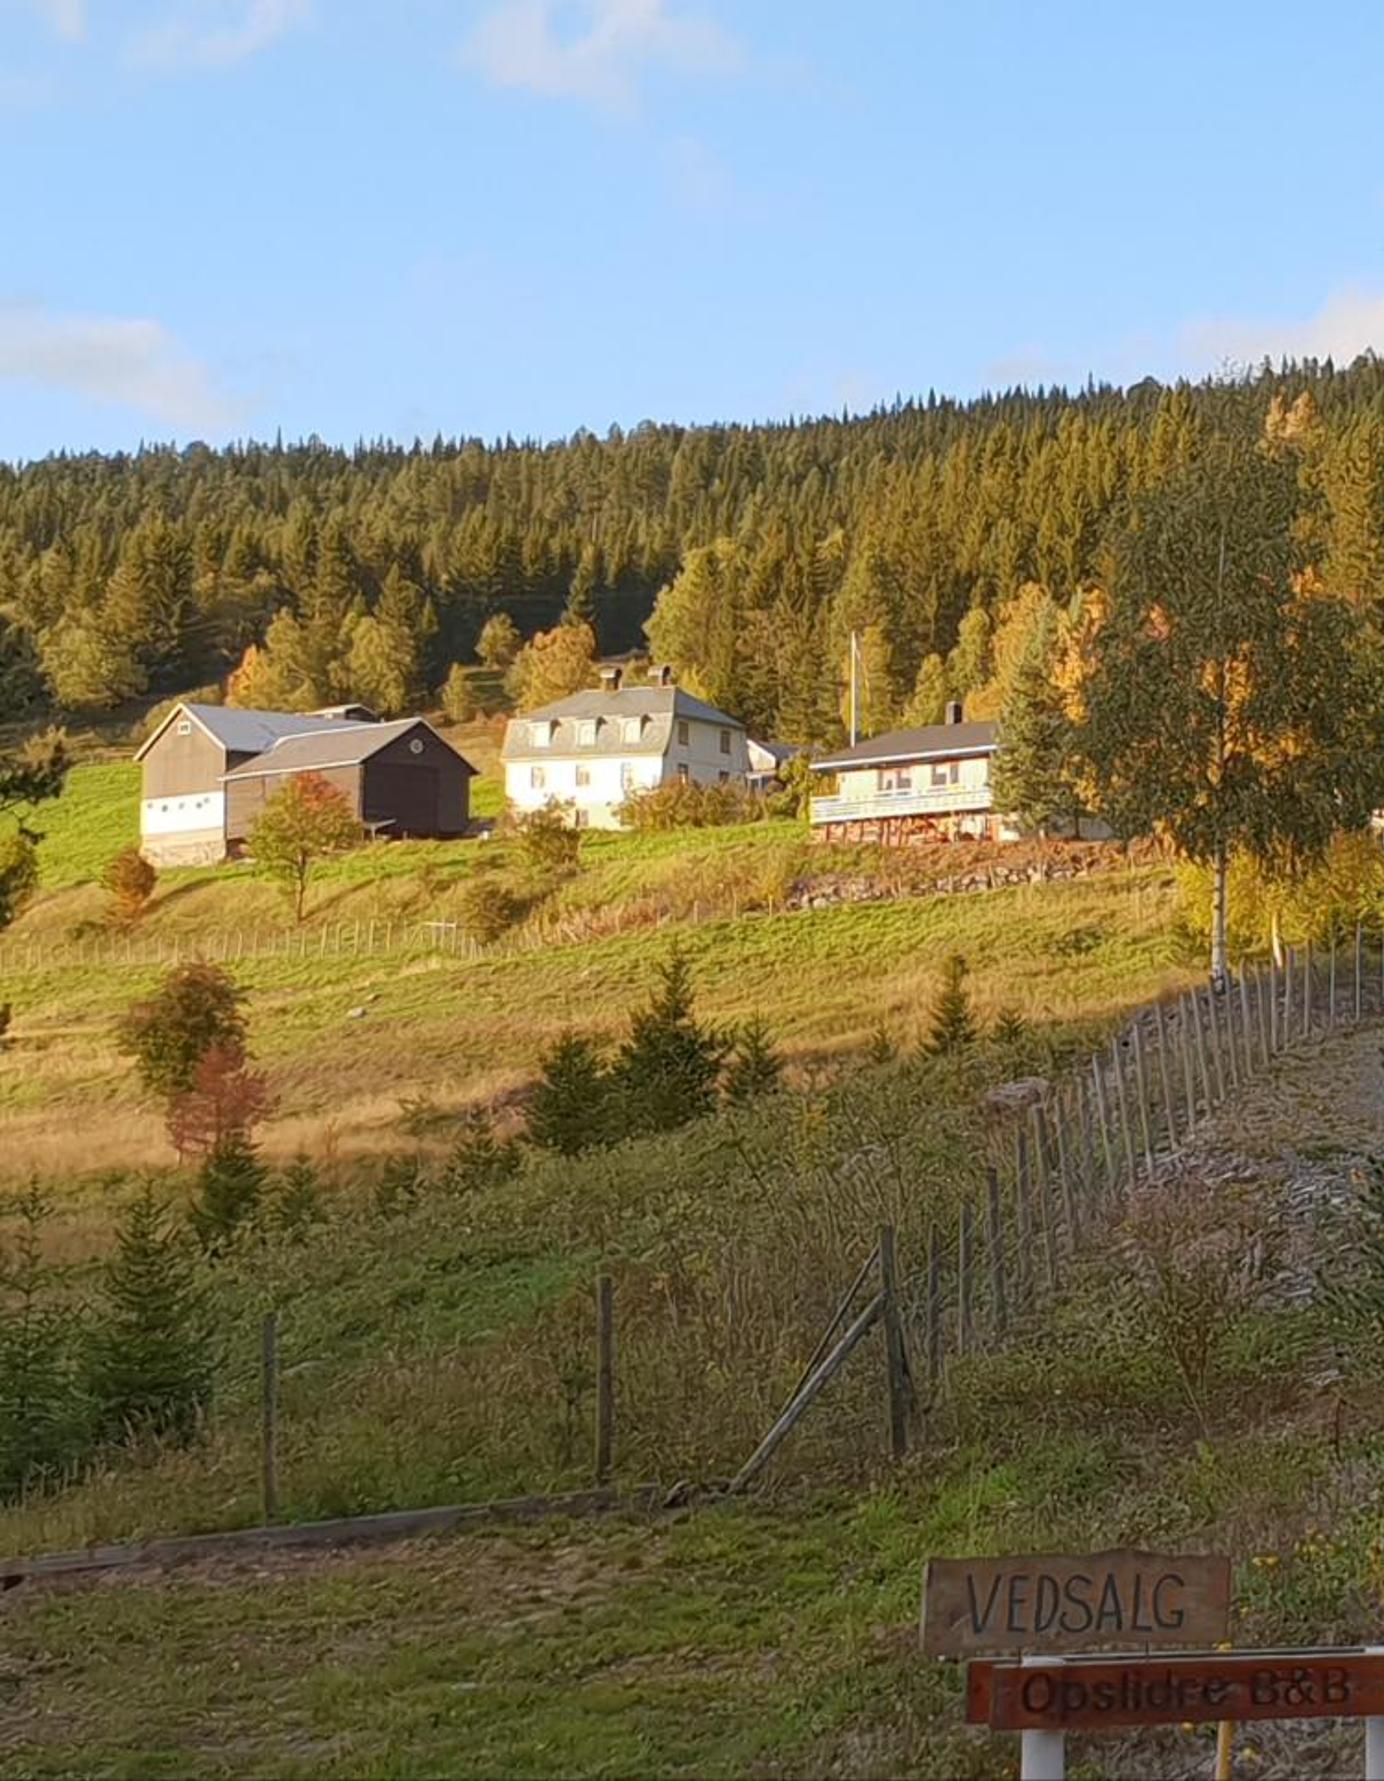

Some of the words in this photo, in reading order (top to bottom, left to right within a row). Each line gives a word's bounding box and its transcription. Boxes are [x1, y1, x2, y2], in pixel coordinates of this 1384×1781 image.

[966, 1573, 1185, 1633] VEDSALG
[1021, 1668, 1226, 1718] Opslidre
[1249, 1667, 1351, 1706] B&B
